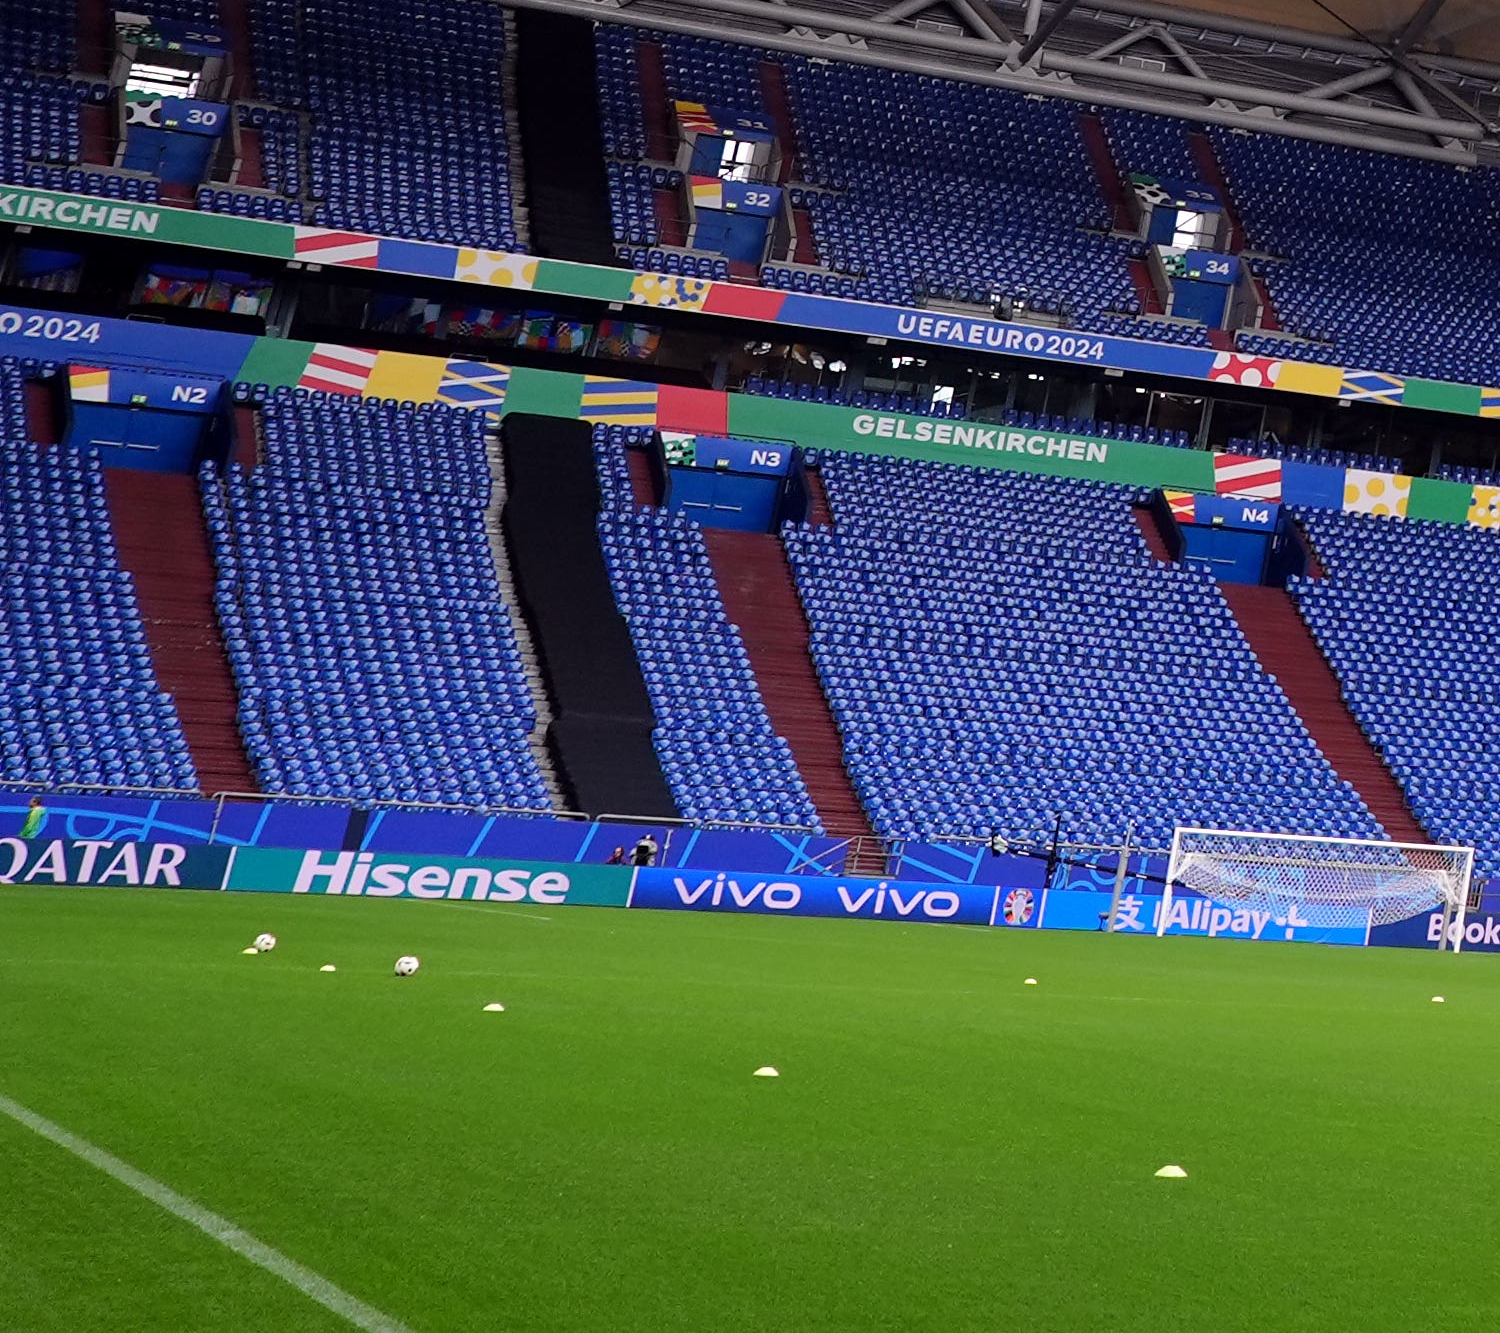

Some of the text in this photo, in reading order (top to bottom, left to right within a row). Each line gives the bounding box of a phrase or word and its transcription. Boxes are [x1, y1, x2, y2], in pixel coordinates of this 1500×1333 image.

[186, 109, 218, 126] 30
[737, 118, 769, 131] 31
[744, 191, 771, 208] 32
[1206, 260, 1230, 275] 34
[172, 385, 207, 404] N2
[853, 414, 1109, 465] GELSENKIRCHEN
[750, 450, 781, 467] N3
[1241, 507, 1269, 524] N4
[291, 849, 570, 904] Hisense
